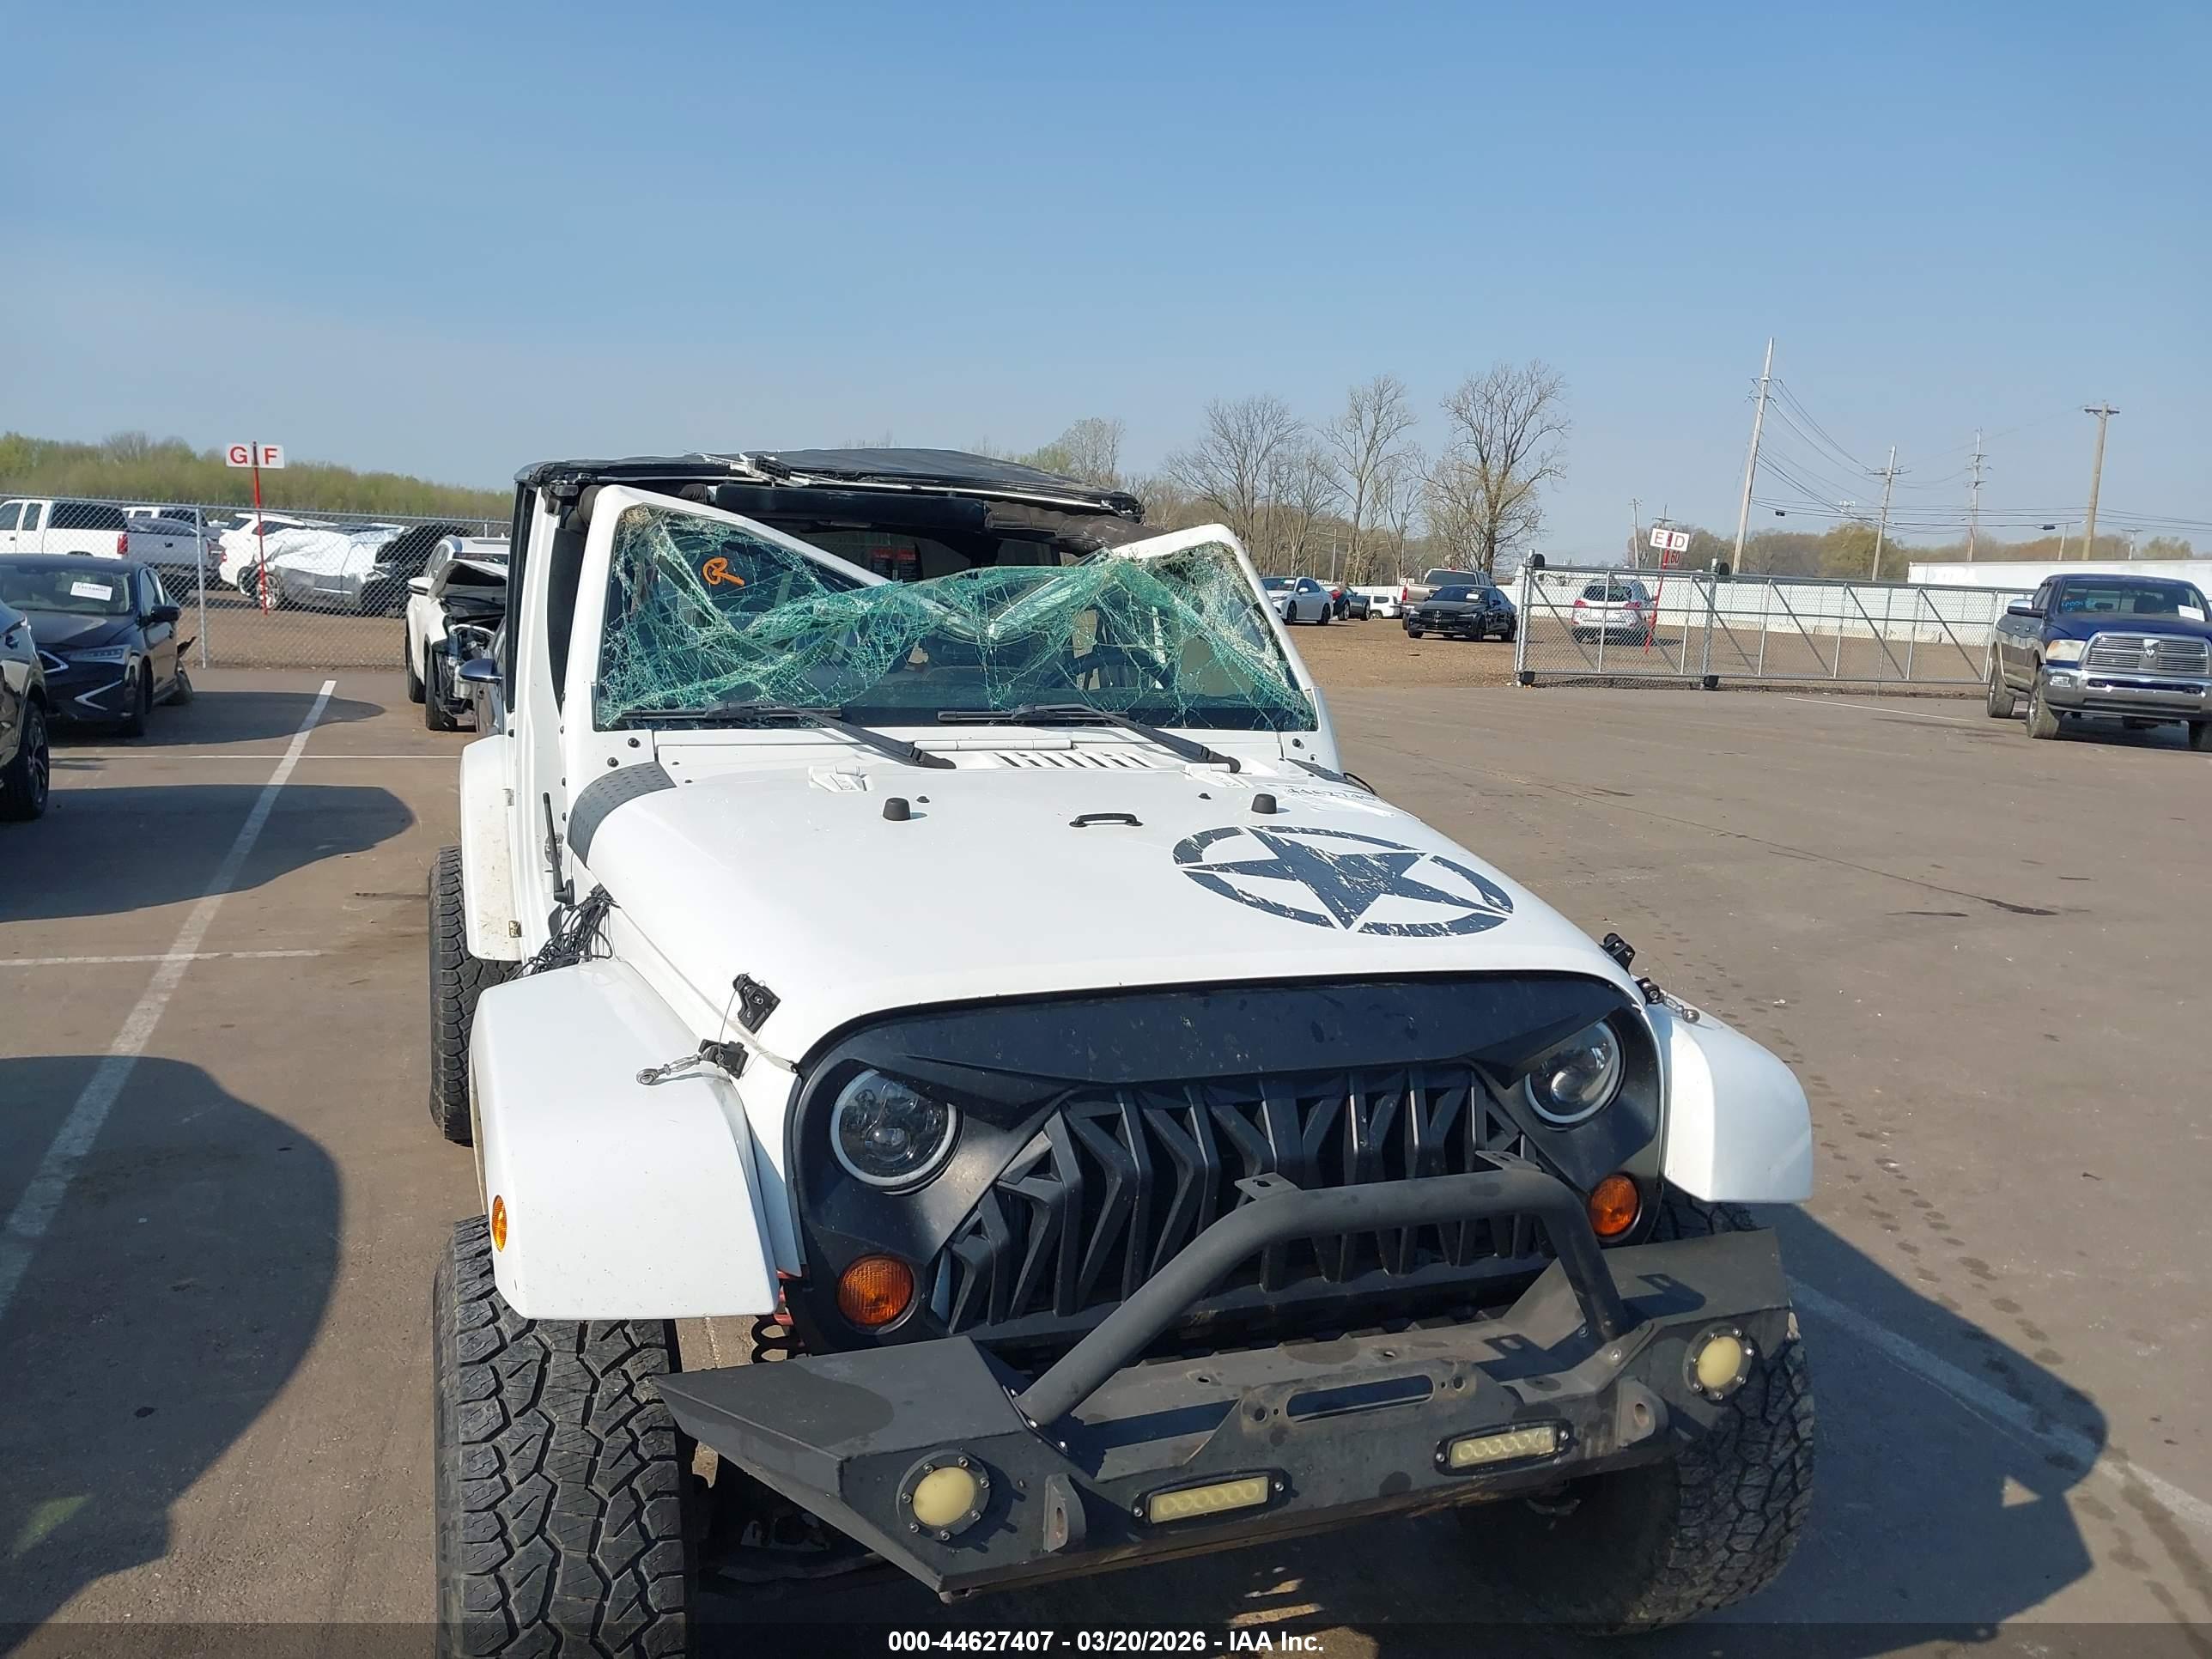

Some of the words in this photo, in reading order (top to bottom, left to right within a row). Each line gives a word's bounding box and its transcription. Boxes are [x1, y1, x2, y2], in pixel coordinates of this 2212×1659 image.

[229, 446, 248, 465] G
[264, 447, 278, 465] F
[1654, 532, 1665, 545] E
[1674, 534, 1686, 548] D
